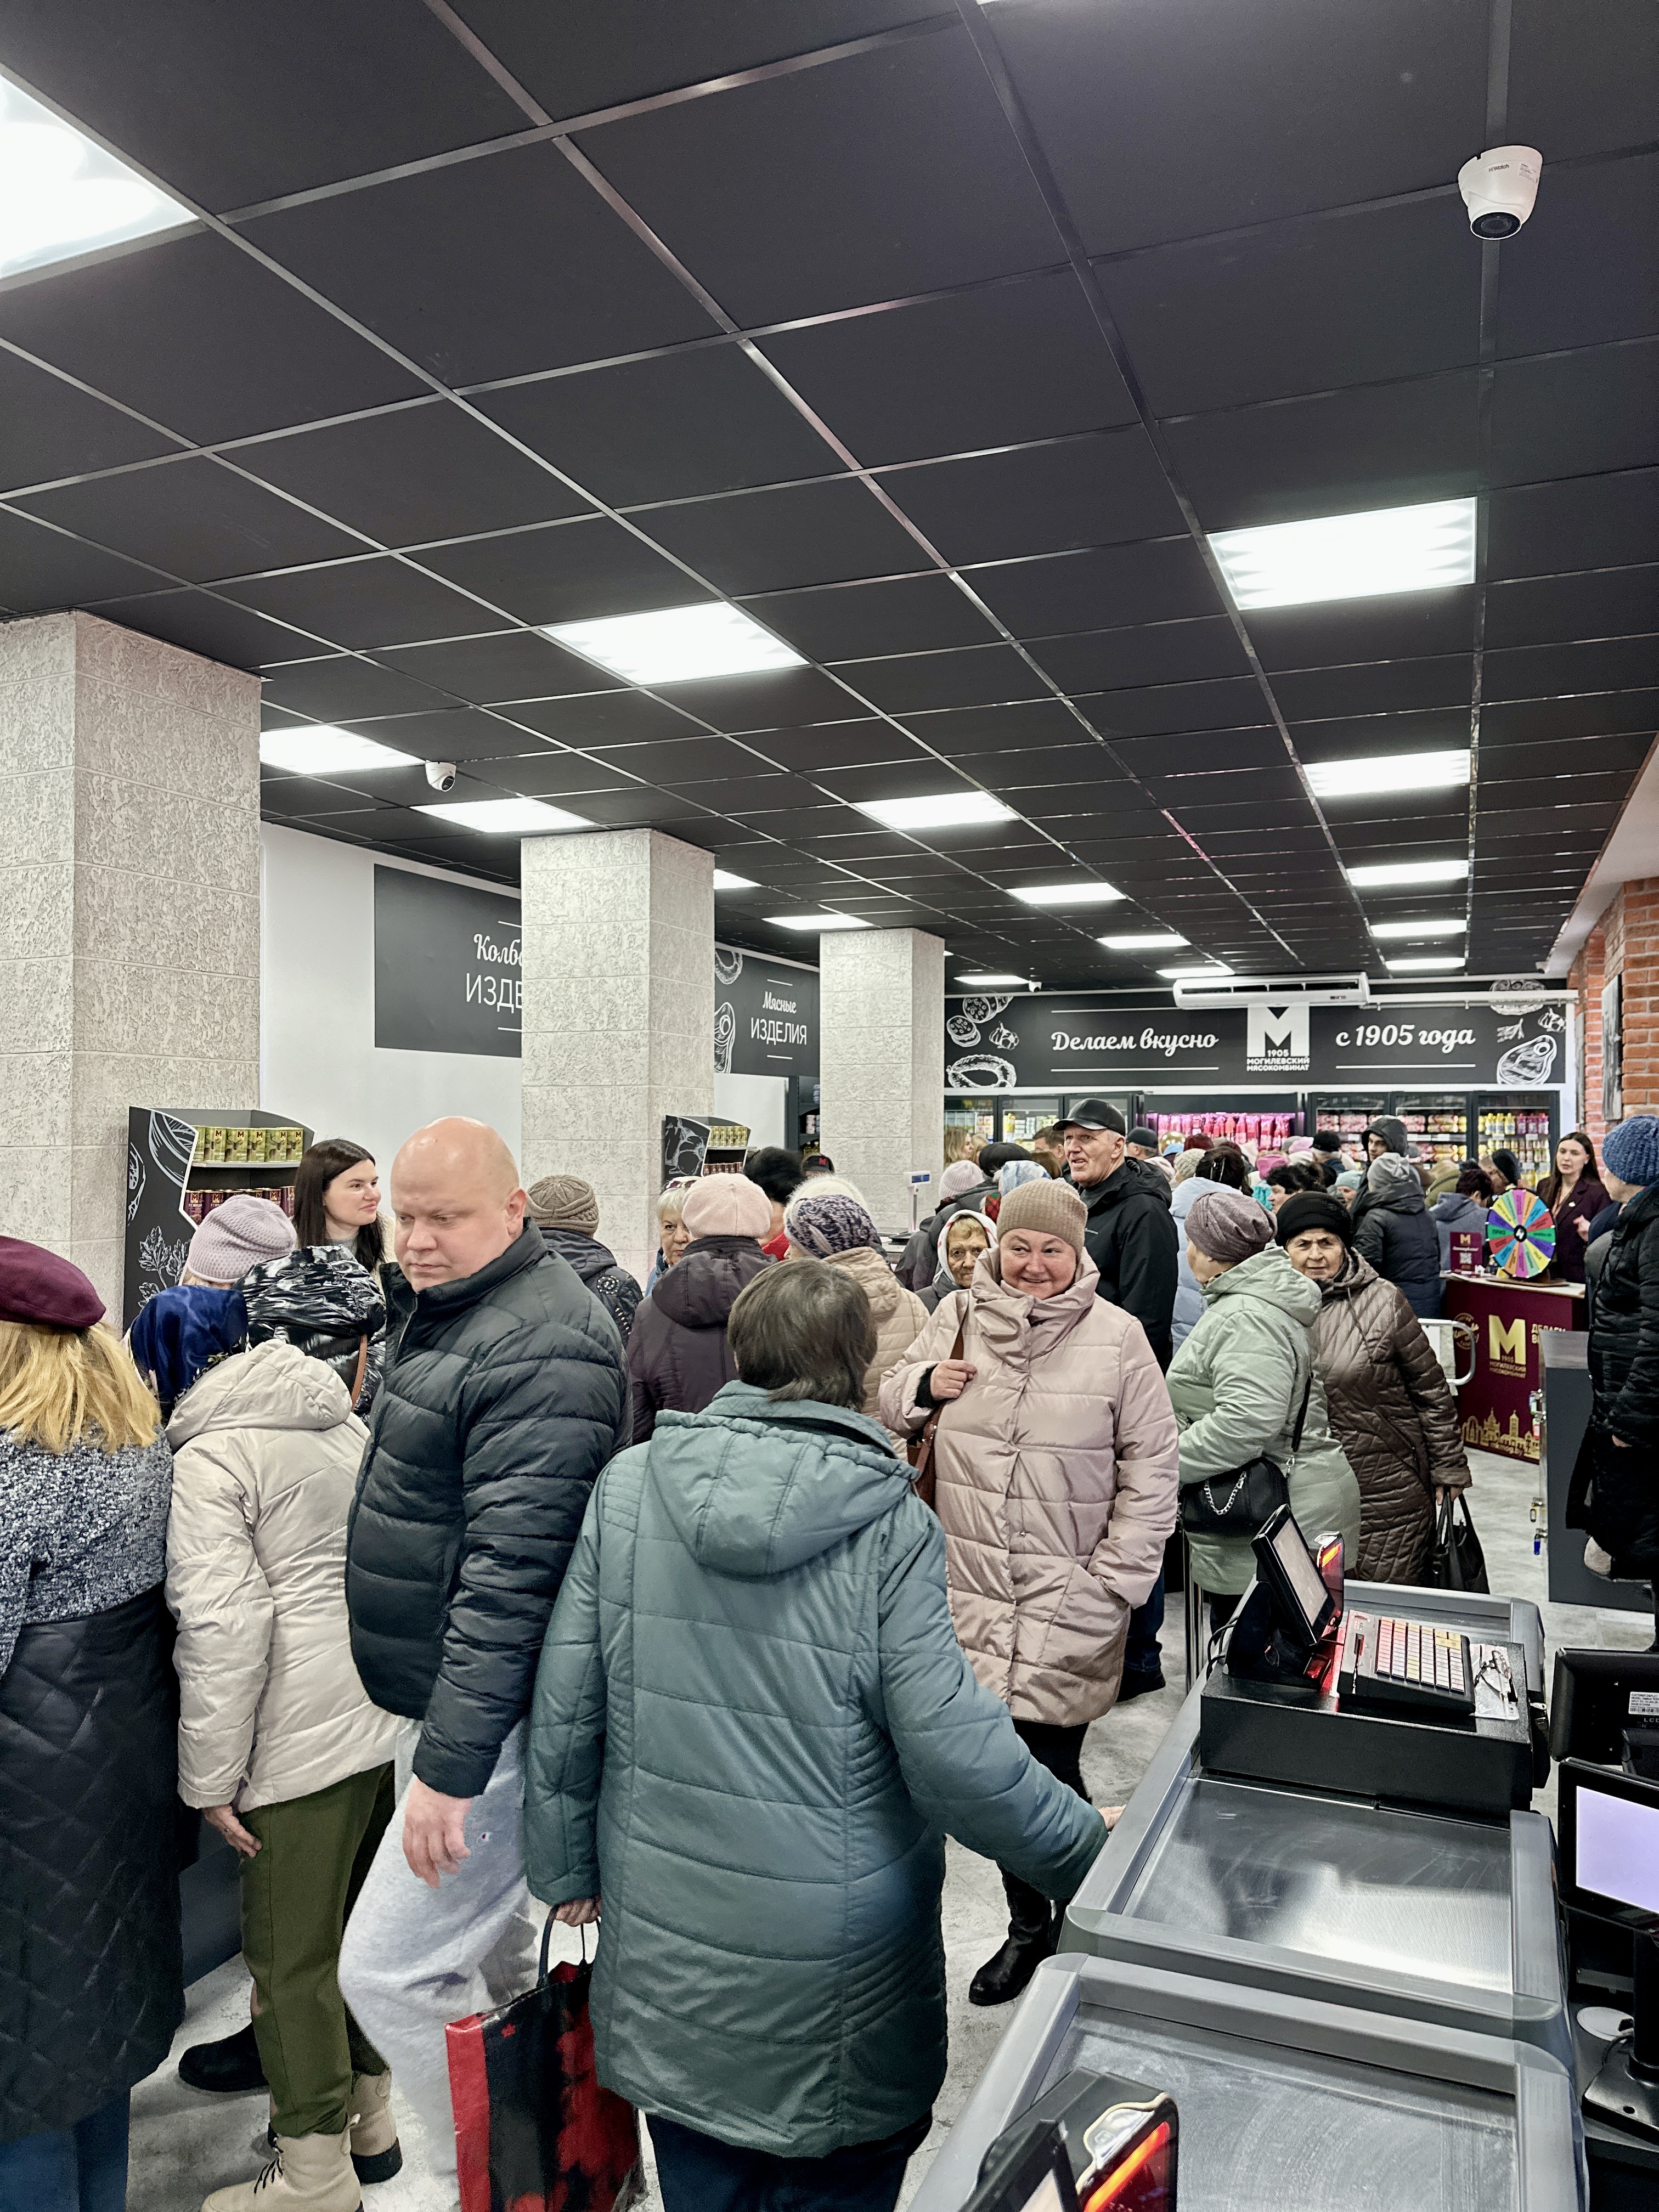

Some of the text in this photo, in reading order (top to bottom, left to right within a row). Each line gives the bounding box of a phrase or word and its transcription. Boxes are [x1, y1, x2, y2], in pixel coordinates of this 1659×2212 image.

[762, 991, 797, 1014] Мясные
[751, 1017, 807, 1046] ИЗДЕЛИЯ
[1051, 1028, 1219, 1057] Делаем вкусно
[1335, 1024, 1476, 1054] с 1905 года
[1246, 1056, 1310, 1065] МОГИЛЕВСКИЙ
[1267, 1049, 1289, 1057] 1905
